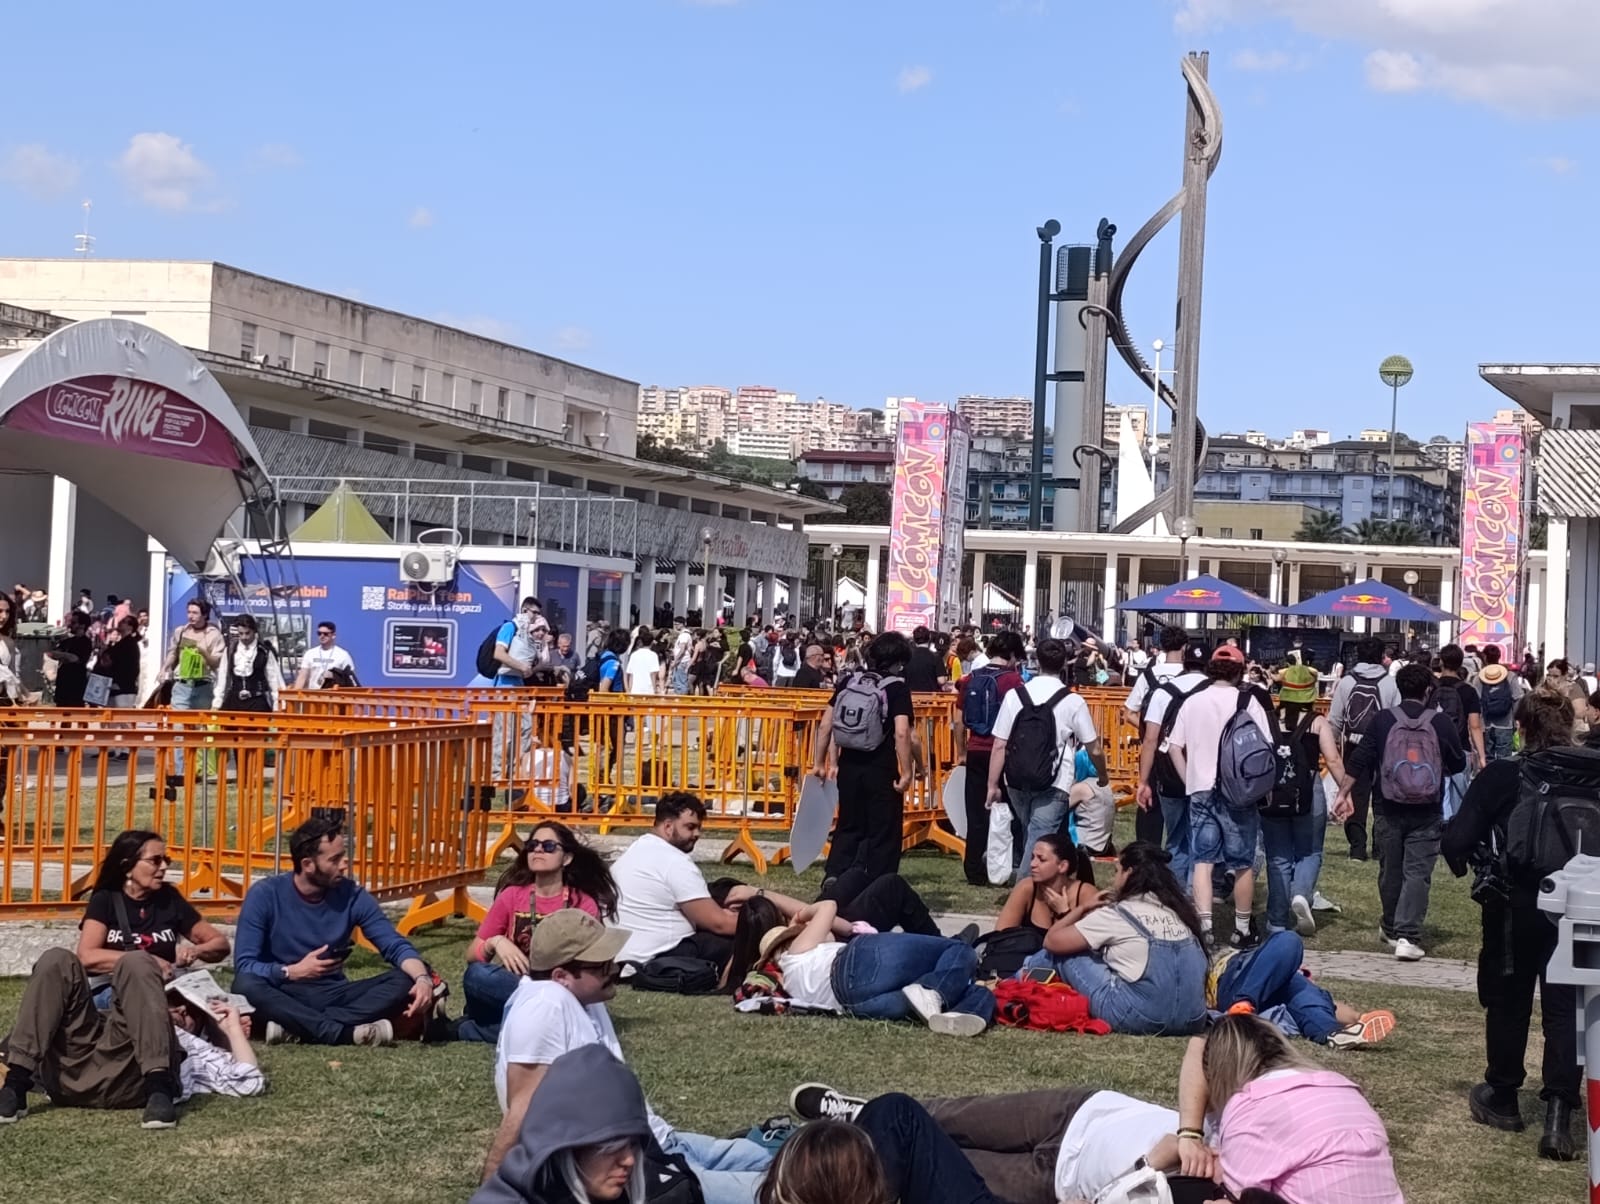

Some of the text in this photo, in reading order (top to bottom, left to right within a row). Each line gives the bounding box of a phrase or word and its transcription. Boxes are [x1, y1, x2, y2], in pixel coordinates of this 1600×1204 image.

[53, 389, 102, 423] COMICON
[100, 377, 168, 444] RING
[898, 445, 937, 591] COMICON
[1471, 467, 1512, 620] COMICON
[387, 601, 411, 611] Storie
[418, 604, 443, 613] prova
[452, 603, 482, 615] ragazzi
